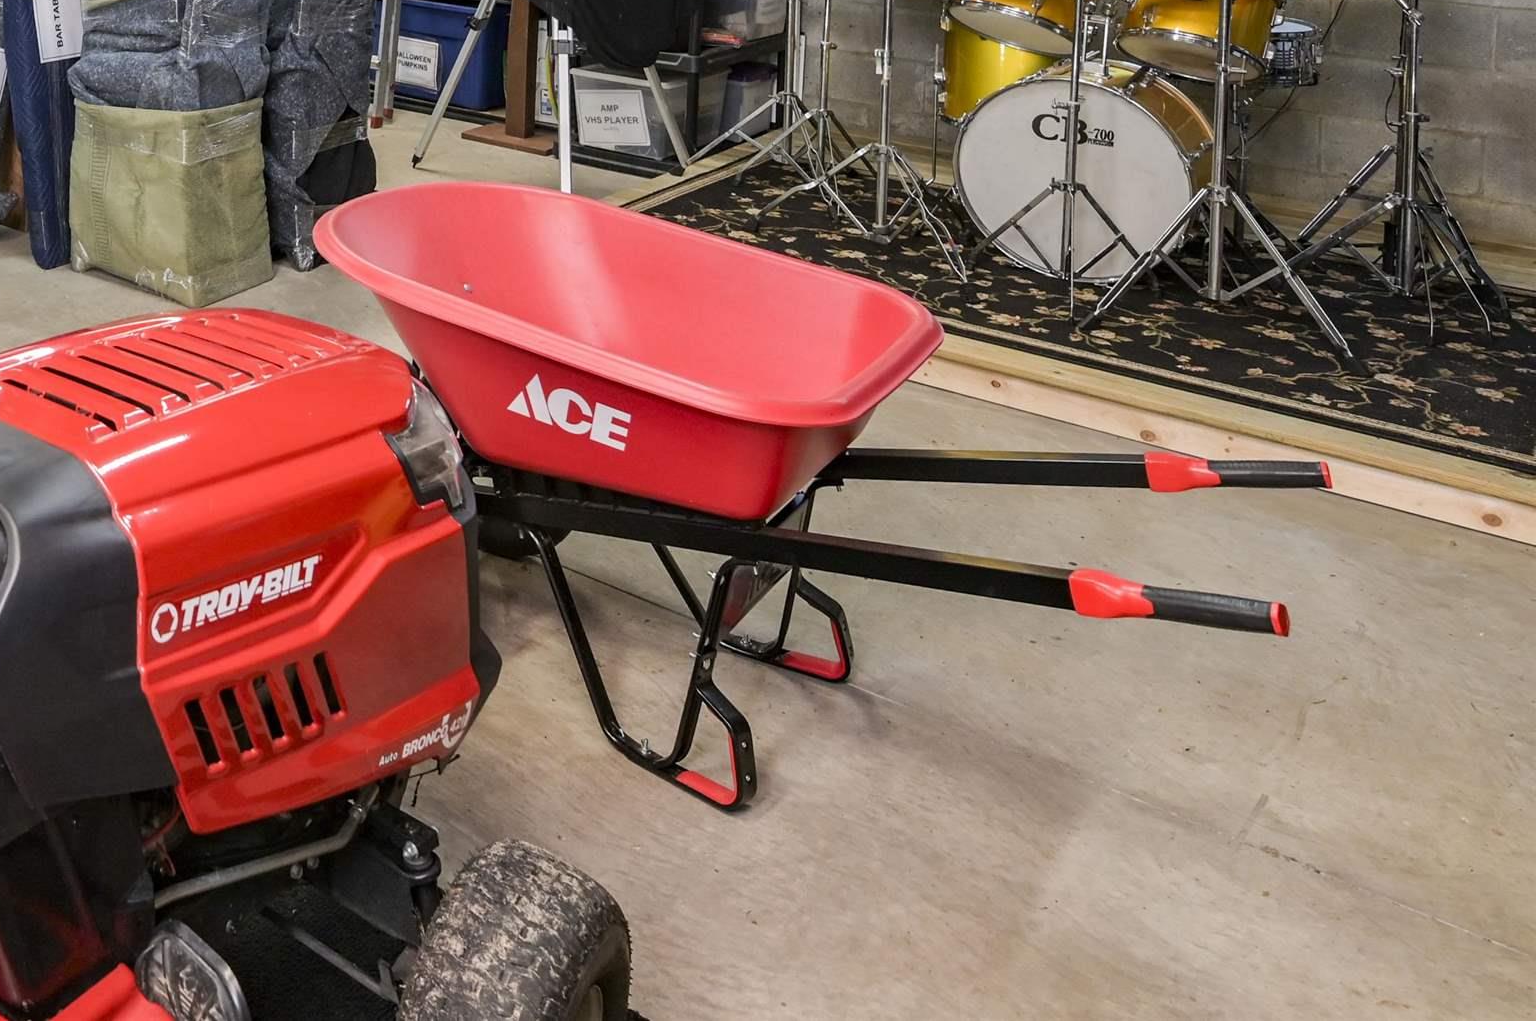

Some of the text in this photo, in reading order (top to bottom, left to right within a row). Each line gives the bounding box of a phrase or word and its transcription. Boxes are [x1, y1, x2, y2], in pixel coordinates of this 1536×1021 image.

[56, 26, 64, 49] BAR
[398, 51, 432, 65] ALLOWEEN
[600, 104, 619, 113] AMP
[585, 116, 640, 126] VHS PLAYER
[506, 373, 632, 452] ACE
[180, 554, 320, 630] TROY-BILT
[378, 750, 399, 767] Auto
[401, 725, 448, 759] BRONCO
